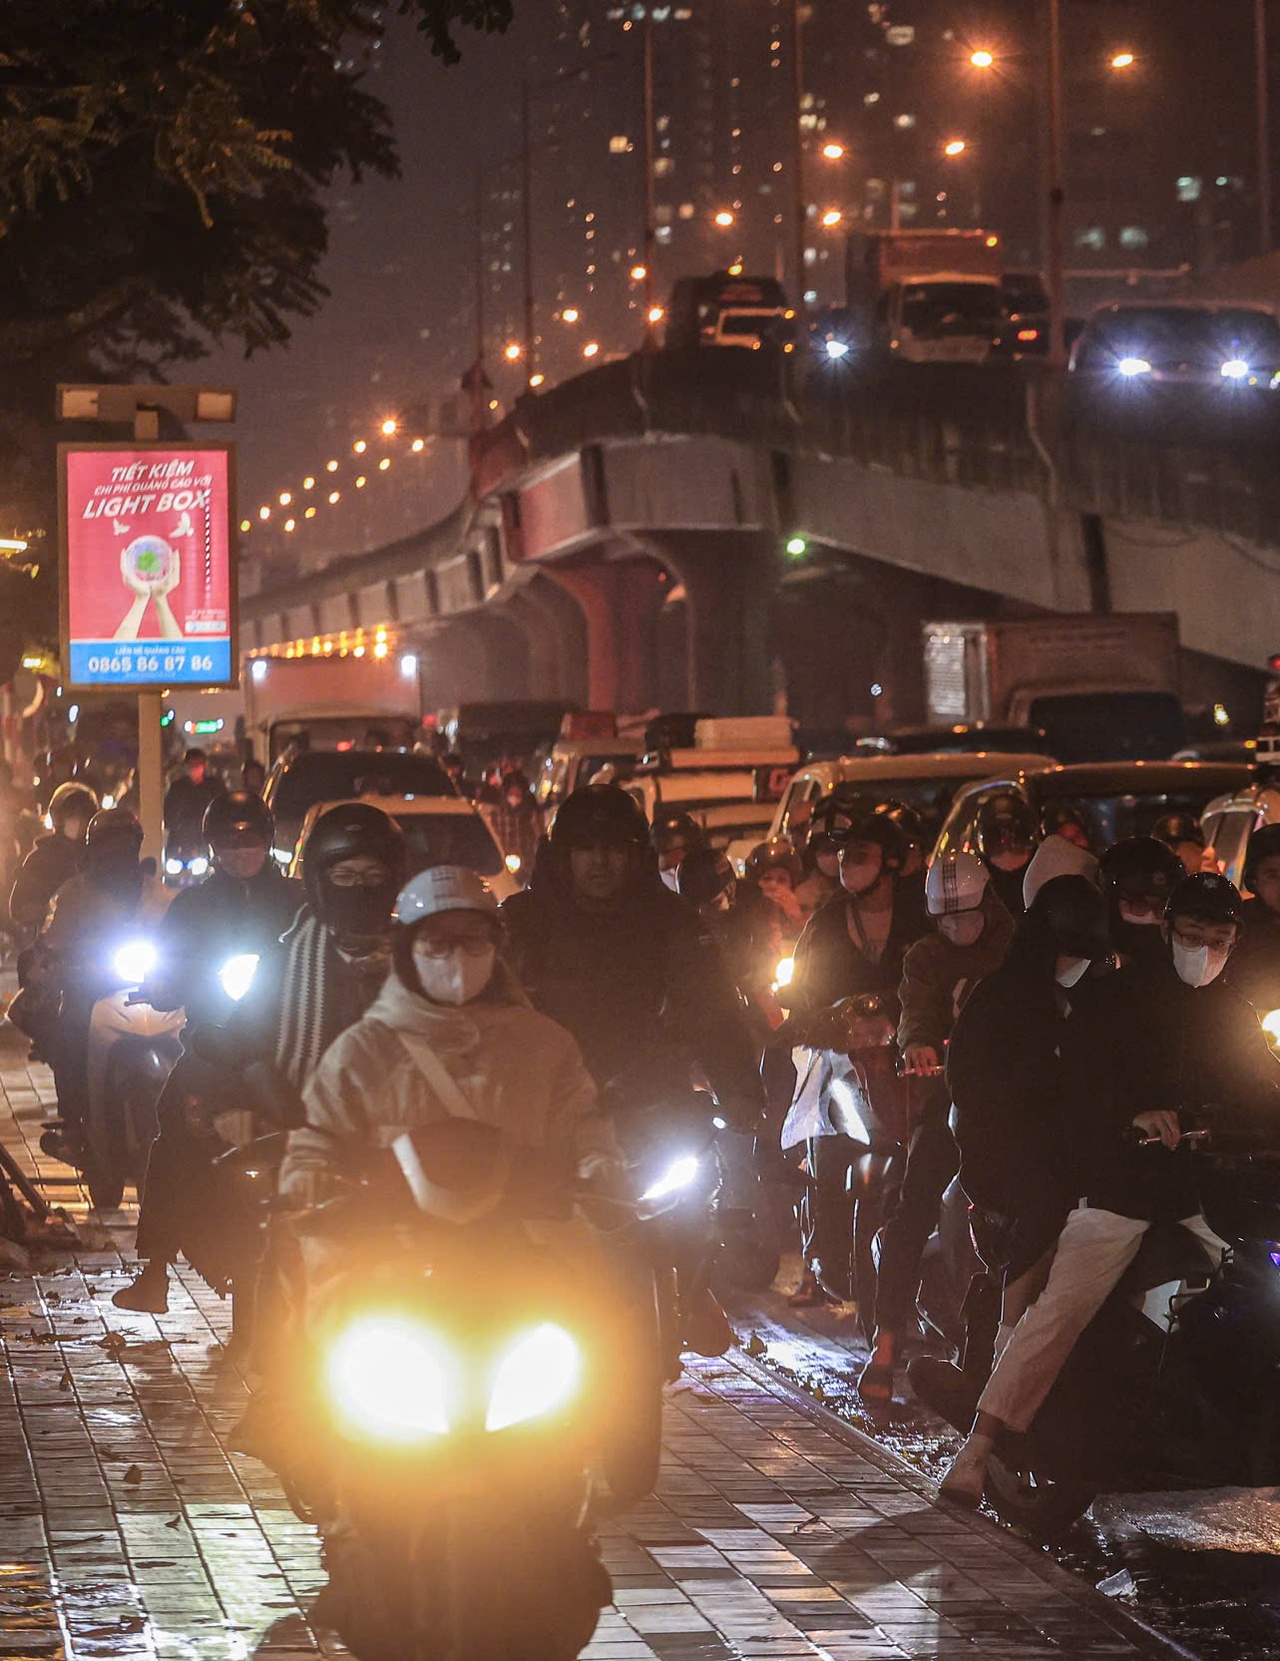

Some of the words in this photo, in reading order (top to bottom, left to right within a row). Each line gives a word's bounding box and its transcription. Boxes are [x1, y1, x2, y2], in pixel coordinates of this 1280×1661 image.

[111, 460, 149, 483] TIẾT
[94, 484, 113, 497] CHI
[82, 493, 157, 519] LIGHT
[155, 488, 212, 513] BOX
[137, 655, 159, 672] 86
[164, 655, 185, 671] 87
[190, 654, 213, 672] 86
